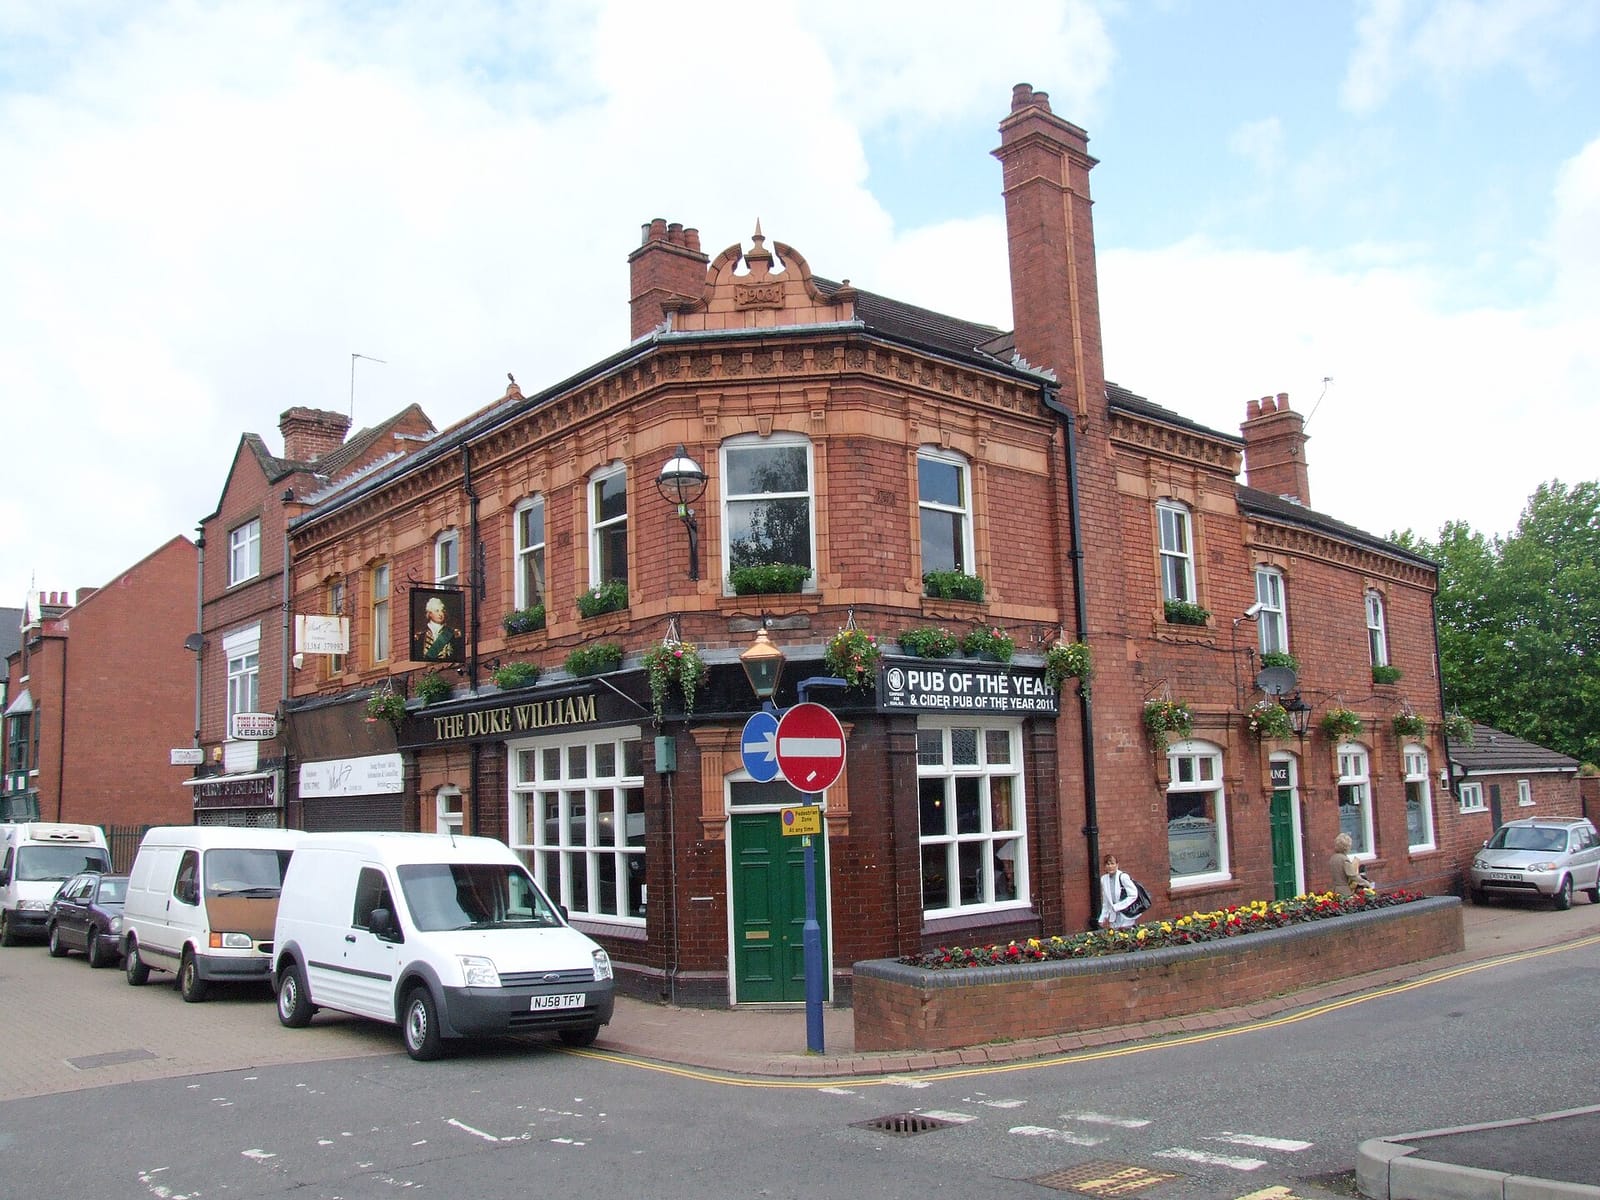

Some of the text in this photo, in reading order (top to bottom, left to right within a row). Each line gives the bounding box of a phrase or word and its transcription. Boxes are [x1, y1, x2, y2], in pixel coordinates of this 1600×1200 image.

[908, 670, 1055, 696] PUB OF THE YEAR
[910, 693, 1054, 710] & CIDER PUB OF THE YEAR 2011
[237, 716, 251, 727] FISH
[257, 716, 275, 727] CHIPS
[433, 694, 598, 740] THE DUKE WILLIAM
[237, 729, 274, 737] KEBABS
[1270, 769, 1287, 779] UNGE
[535, 994, 582, 1009] NJ58 TFY
